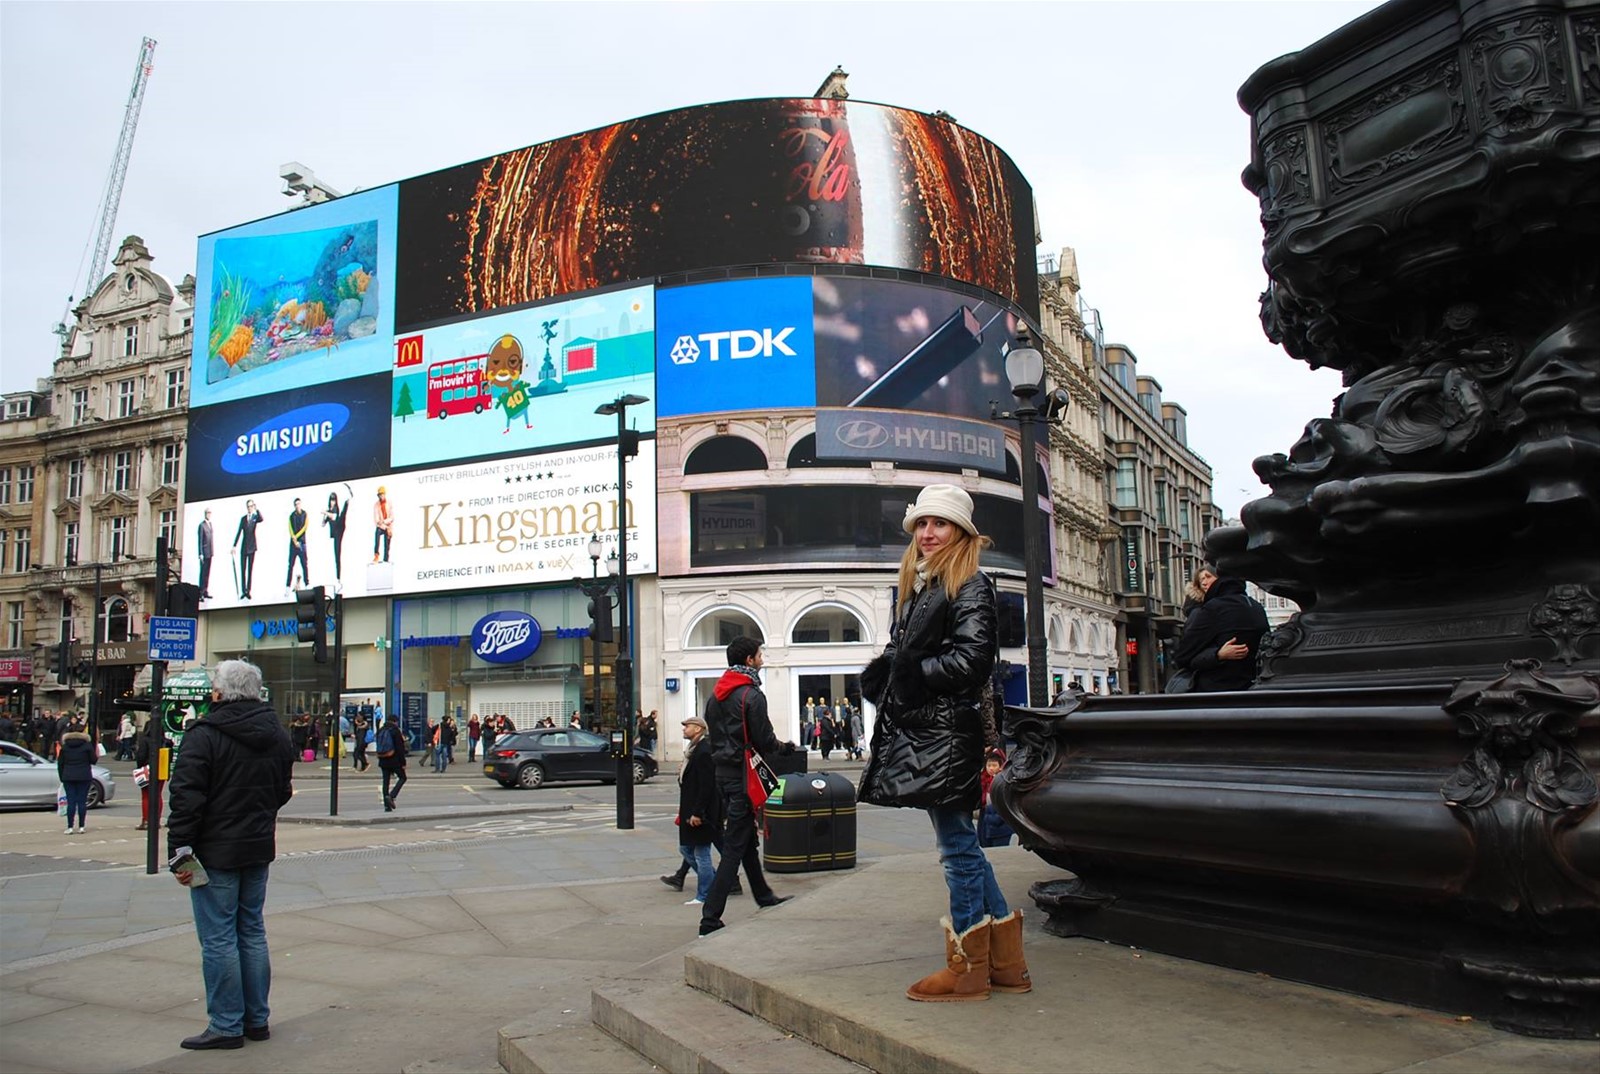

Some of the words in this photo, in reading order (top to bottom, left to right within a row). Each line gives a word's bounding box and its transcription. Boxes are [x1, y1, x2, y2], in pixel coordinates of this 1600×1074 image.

[698, 327, 798, 361] TDK
[507, 390, 525, 409] 40
[236, 420, 333, 457] SAMSUNG
[894, 426, 996, 459] HYUNDAI
[504, 461, 542, 473] STYLISH
[544, 457, 563, 468] AND
[469, 496, 494, 507] FROM
[497, 494, 514, 504] THE
[518, 488, 564, 503] DIRECTOR
[567, 487, 580, 496] OF
[583, 480, 633, 494] KICK-AS
[418, 498, 638, 554] Kingsman
[520, 542, 539, 551] THE
[544, 537, 585, 549] SECRET
[598, 532, 639, 544] ERVCE
[417, 567, 472, 580] EXPERIENCE
[475, 566, 482, 575] IT
[485, 565, 495, 574] IN
[498, 561, 534, 573] IMAX
[155, 619, 171, 627] BUS
[172, 620, 192, 628] LANE
[152, 642, 171, 650] LOOK
[173, 643, 193, 651] BOTH
[477, 619, 531, 655] Boots
[107, 647, 126, 660] BAR
[162, 651, 182, 659] WAYS
